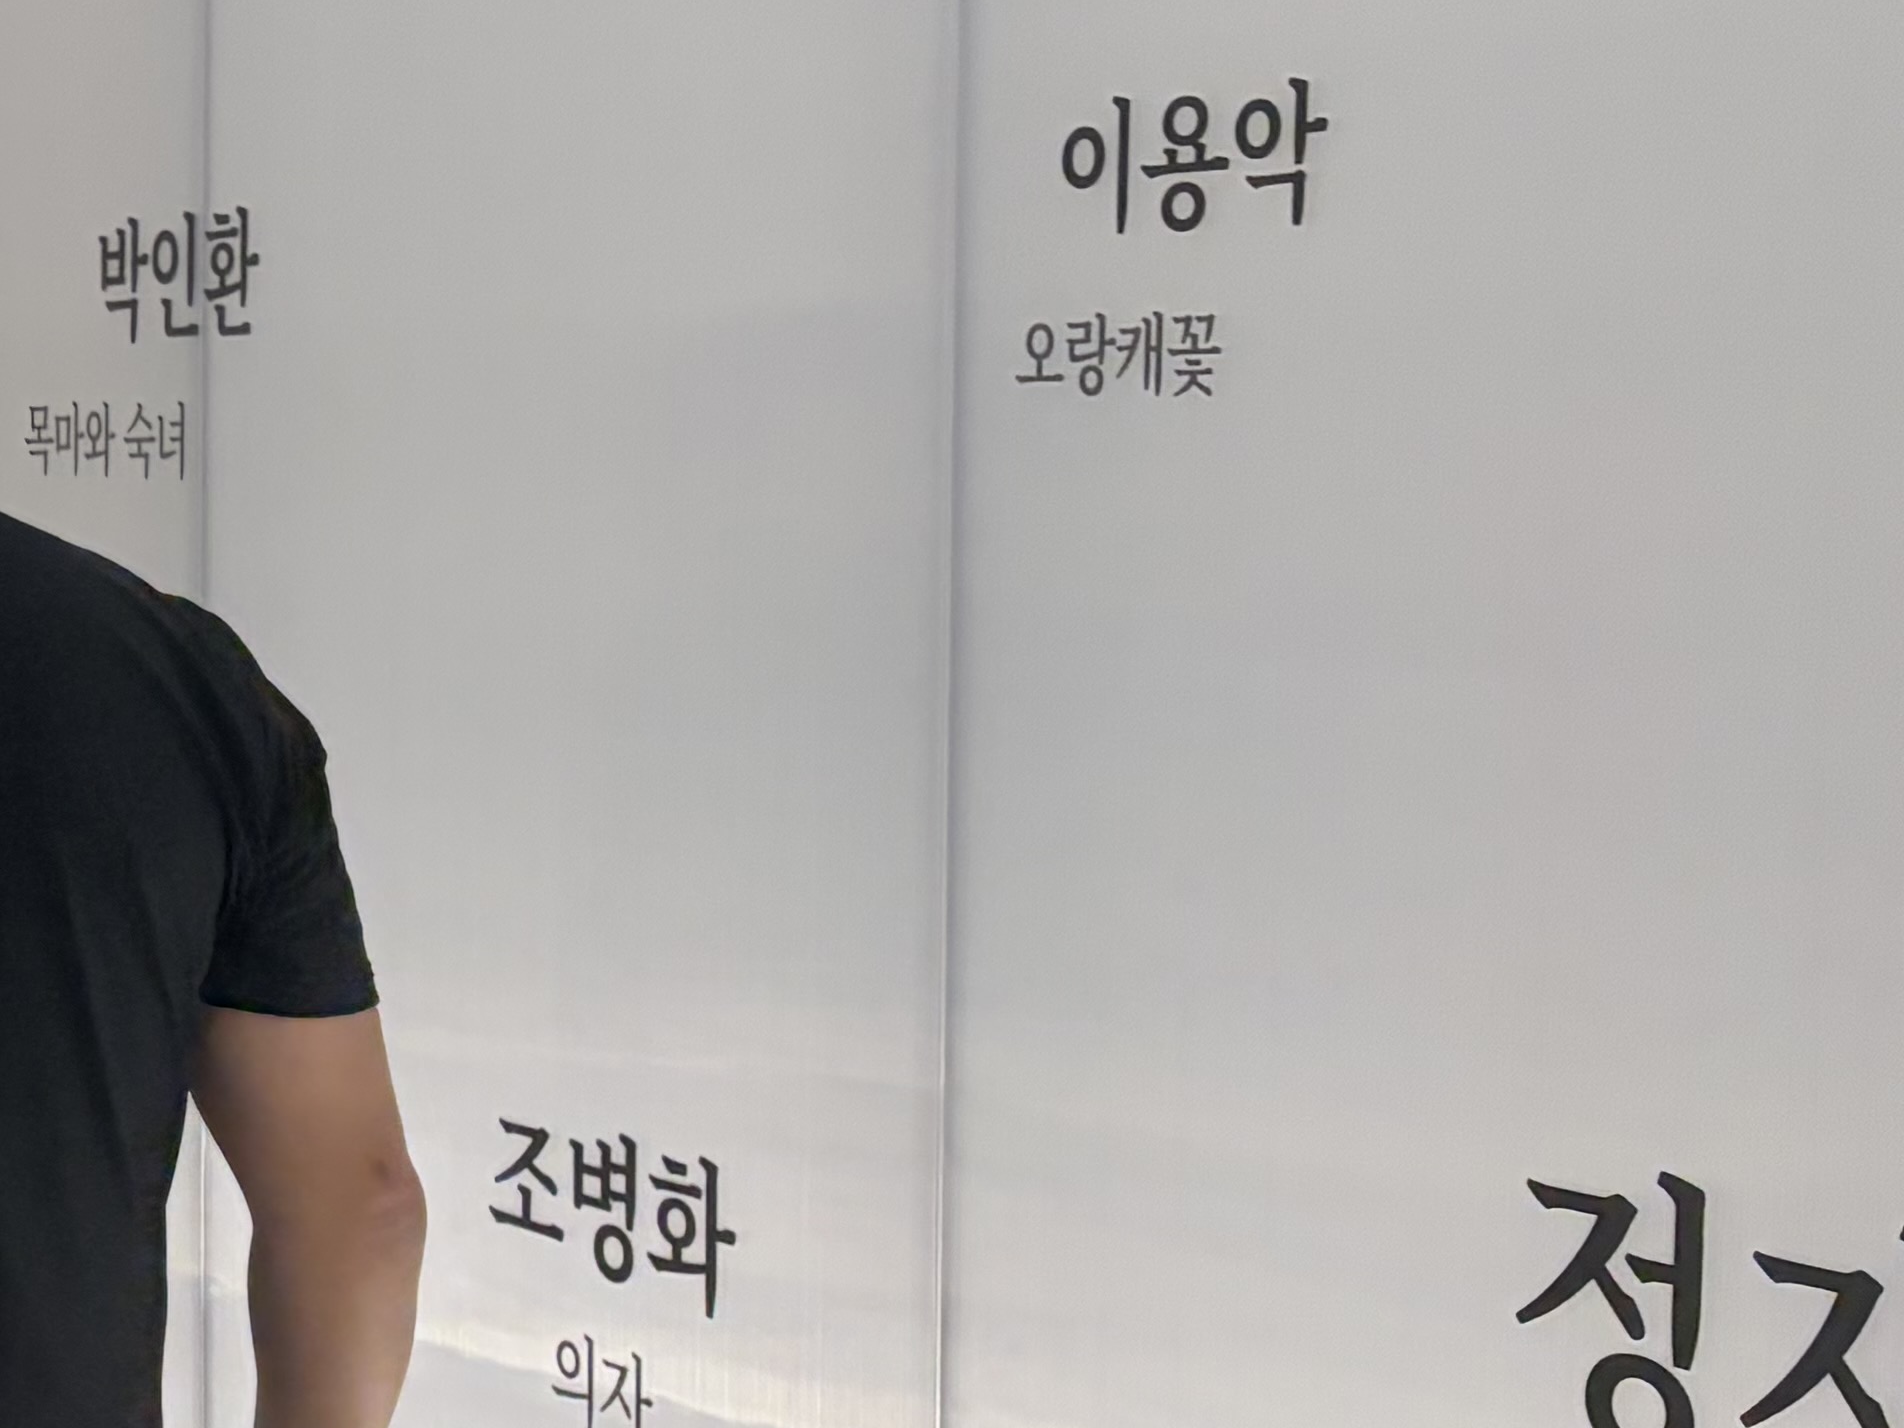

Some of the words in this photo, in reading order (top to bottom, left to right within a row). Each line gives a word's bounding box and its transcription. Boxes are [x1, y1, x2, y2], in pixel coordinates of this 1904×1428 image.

[1061, 77, 1329, 235] 이용악
[98, 205, 261, 345] 박인환
[1015, 310, 1223, 397] 오랑캐꽃
[24, 400, 117, 478] 목마와
[123, 400, 186, 481] 숙녀
[488, 1117, 737, 1320] 조병화
